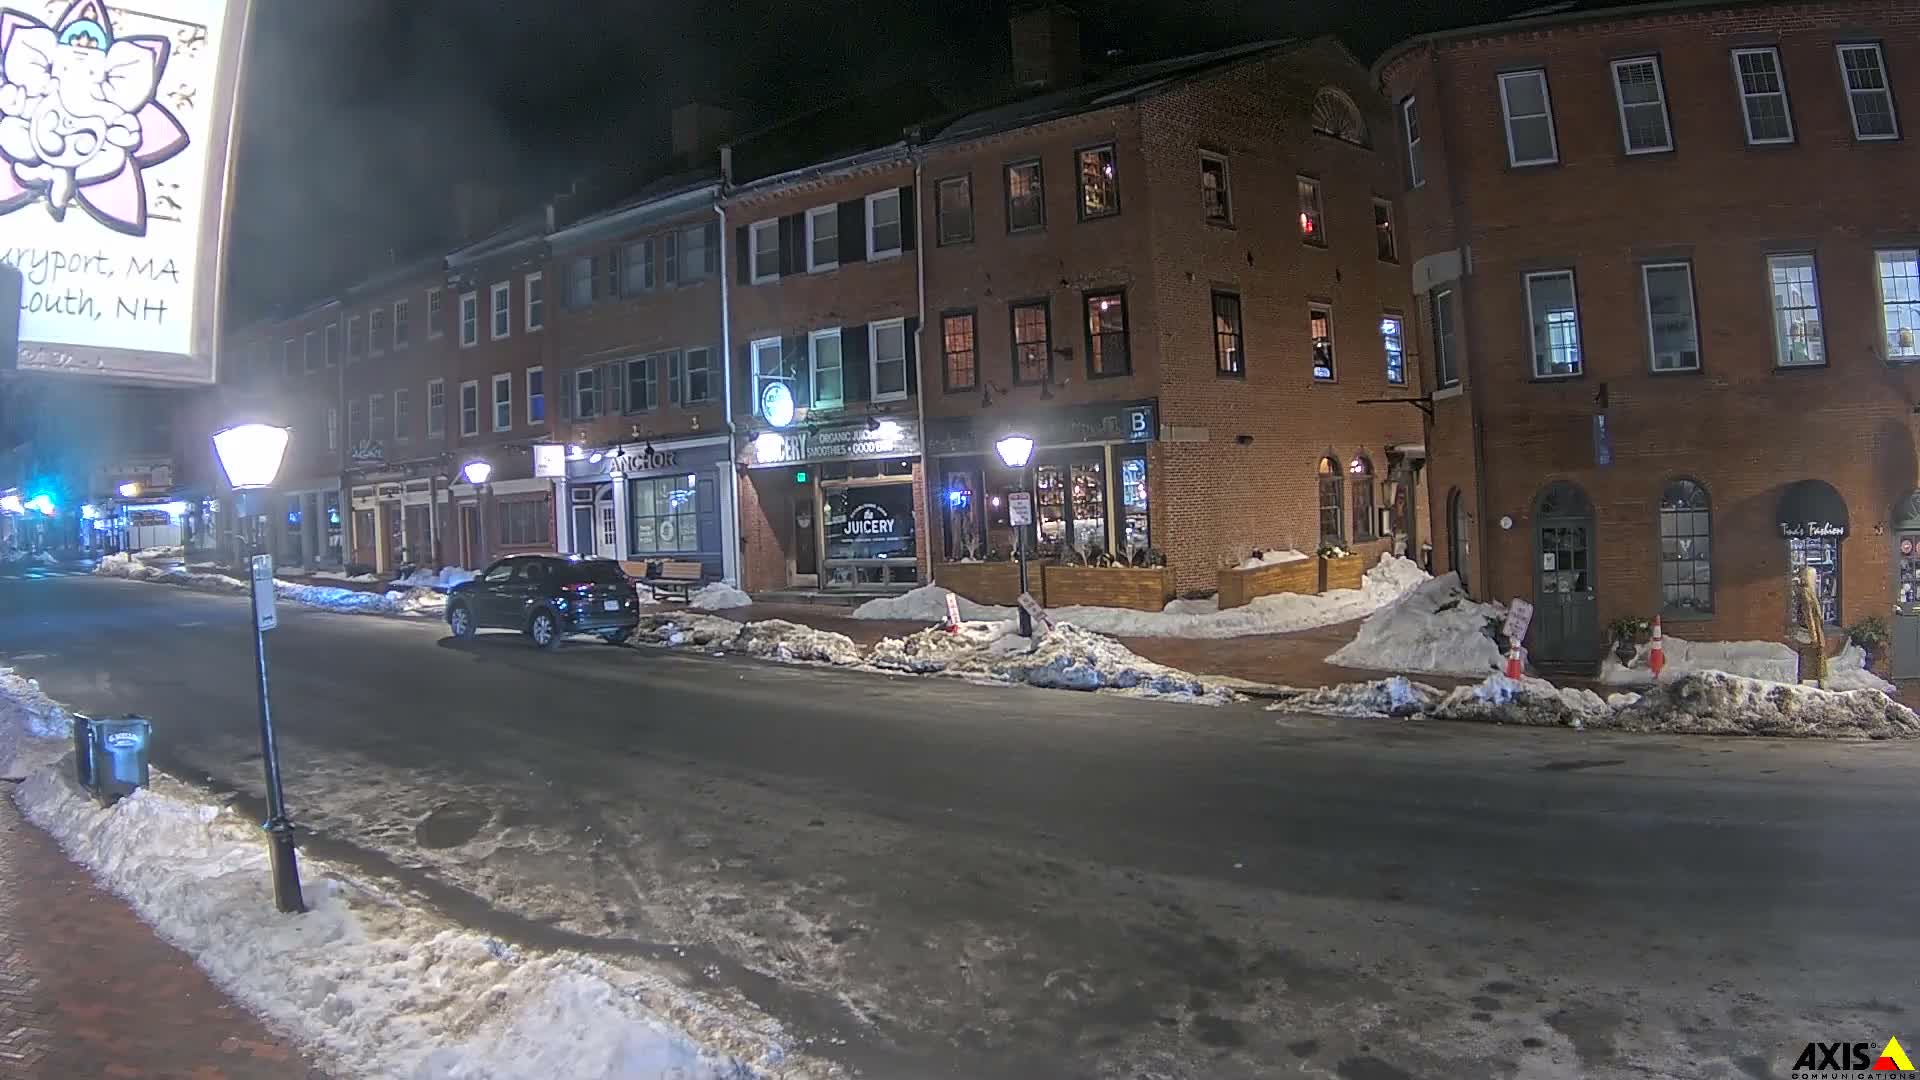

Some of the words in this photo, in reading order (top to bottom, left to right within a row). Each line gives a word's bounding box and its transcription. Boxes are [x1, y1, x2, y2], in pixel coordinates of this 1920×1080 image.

[126, 256, 179, 284] MA
[20, 288, 101, 321] outh,
[116, 296, 168, 325] NH
[1131, 412, 1146, 431] B
[819, 431, 851, 444] ORGANIC
[807, 444, 847, 458] SMOOTHIES
[852, 441, 875, 454] GOOD
[610, 451, 678, 472] ANCHOR
[843, 518, 895, 535] JUICERY
